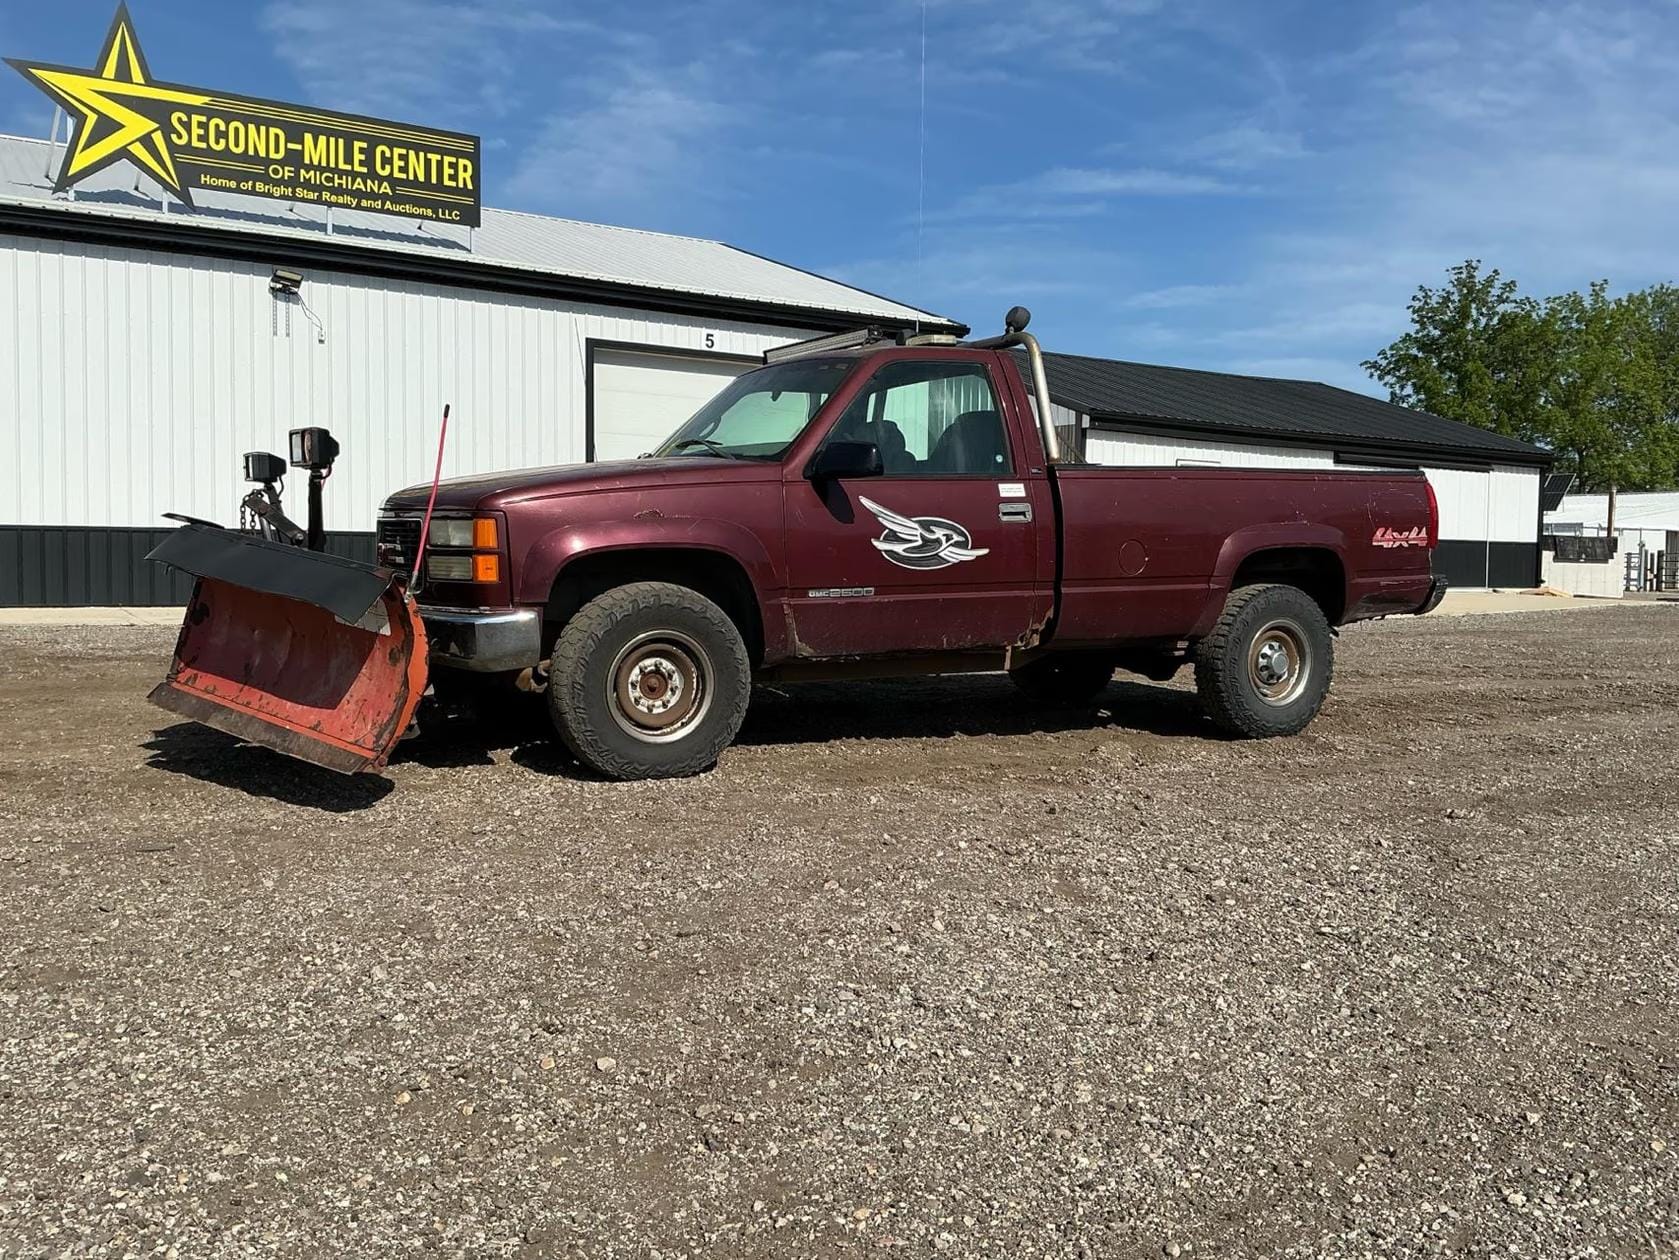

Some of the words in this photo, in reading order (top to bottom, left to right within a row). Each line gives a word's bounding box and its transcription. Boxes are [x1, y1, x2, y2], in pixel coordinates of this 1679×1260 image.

[170, 111, 368, 174] SECOND-MILE
[375, 144, 473, 190] CENTER
[200, 173, 237, 189] Home
[240, 180, 253, 191] of
[255, 181, 293, 197] Bright
[295, 187, 319, 200] Star
[322, 191, 358, 208] Realty
[360, 198, 382, 209] and
[384, 200, 436, 218] Auctions,
[438, 208, 461, 221] LLC
[268, 164, 294, 180] OF
[300, 168, 393, 196] MICHIANA
[705, 333, 715, 349] 5
